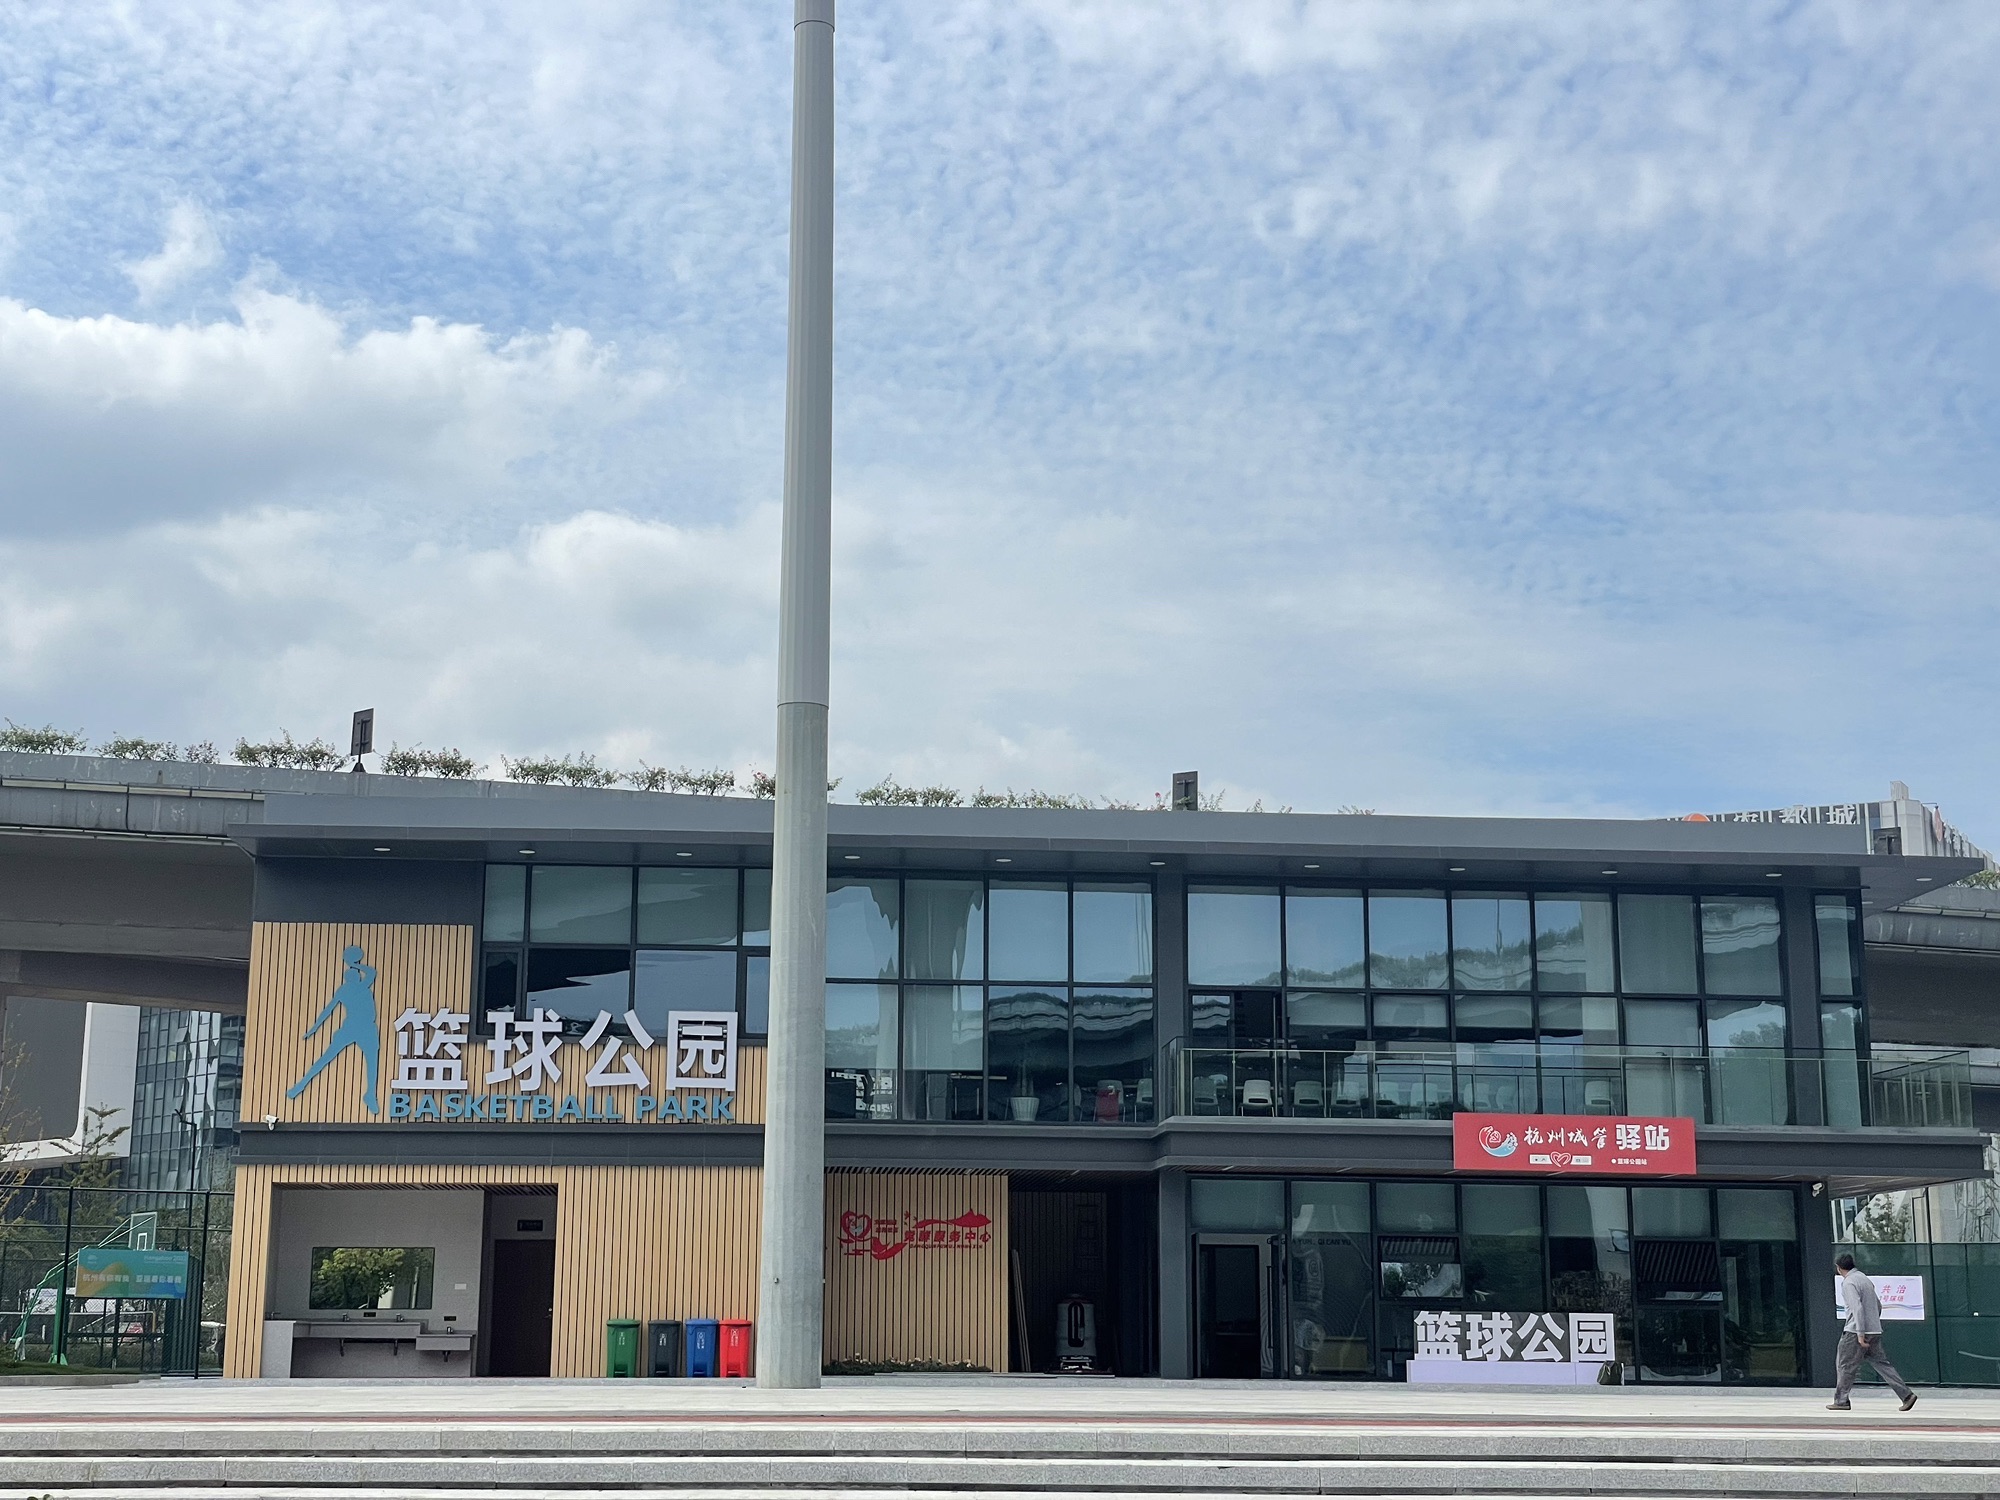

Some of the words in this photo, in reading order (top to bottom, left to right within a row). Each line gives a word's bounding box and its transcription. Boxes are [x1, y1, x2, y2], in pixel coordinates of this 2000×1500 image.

[391, 1008, 738, 1091] 篮球公园
[389, 1093, 622, 1121] BASKETBALL
[636, 1096, 734, 1122] PARK
[904, 1230, 992, 1243] 党群服务中心
[1414, 1310, 1616, 1363] 篮球公园
